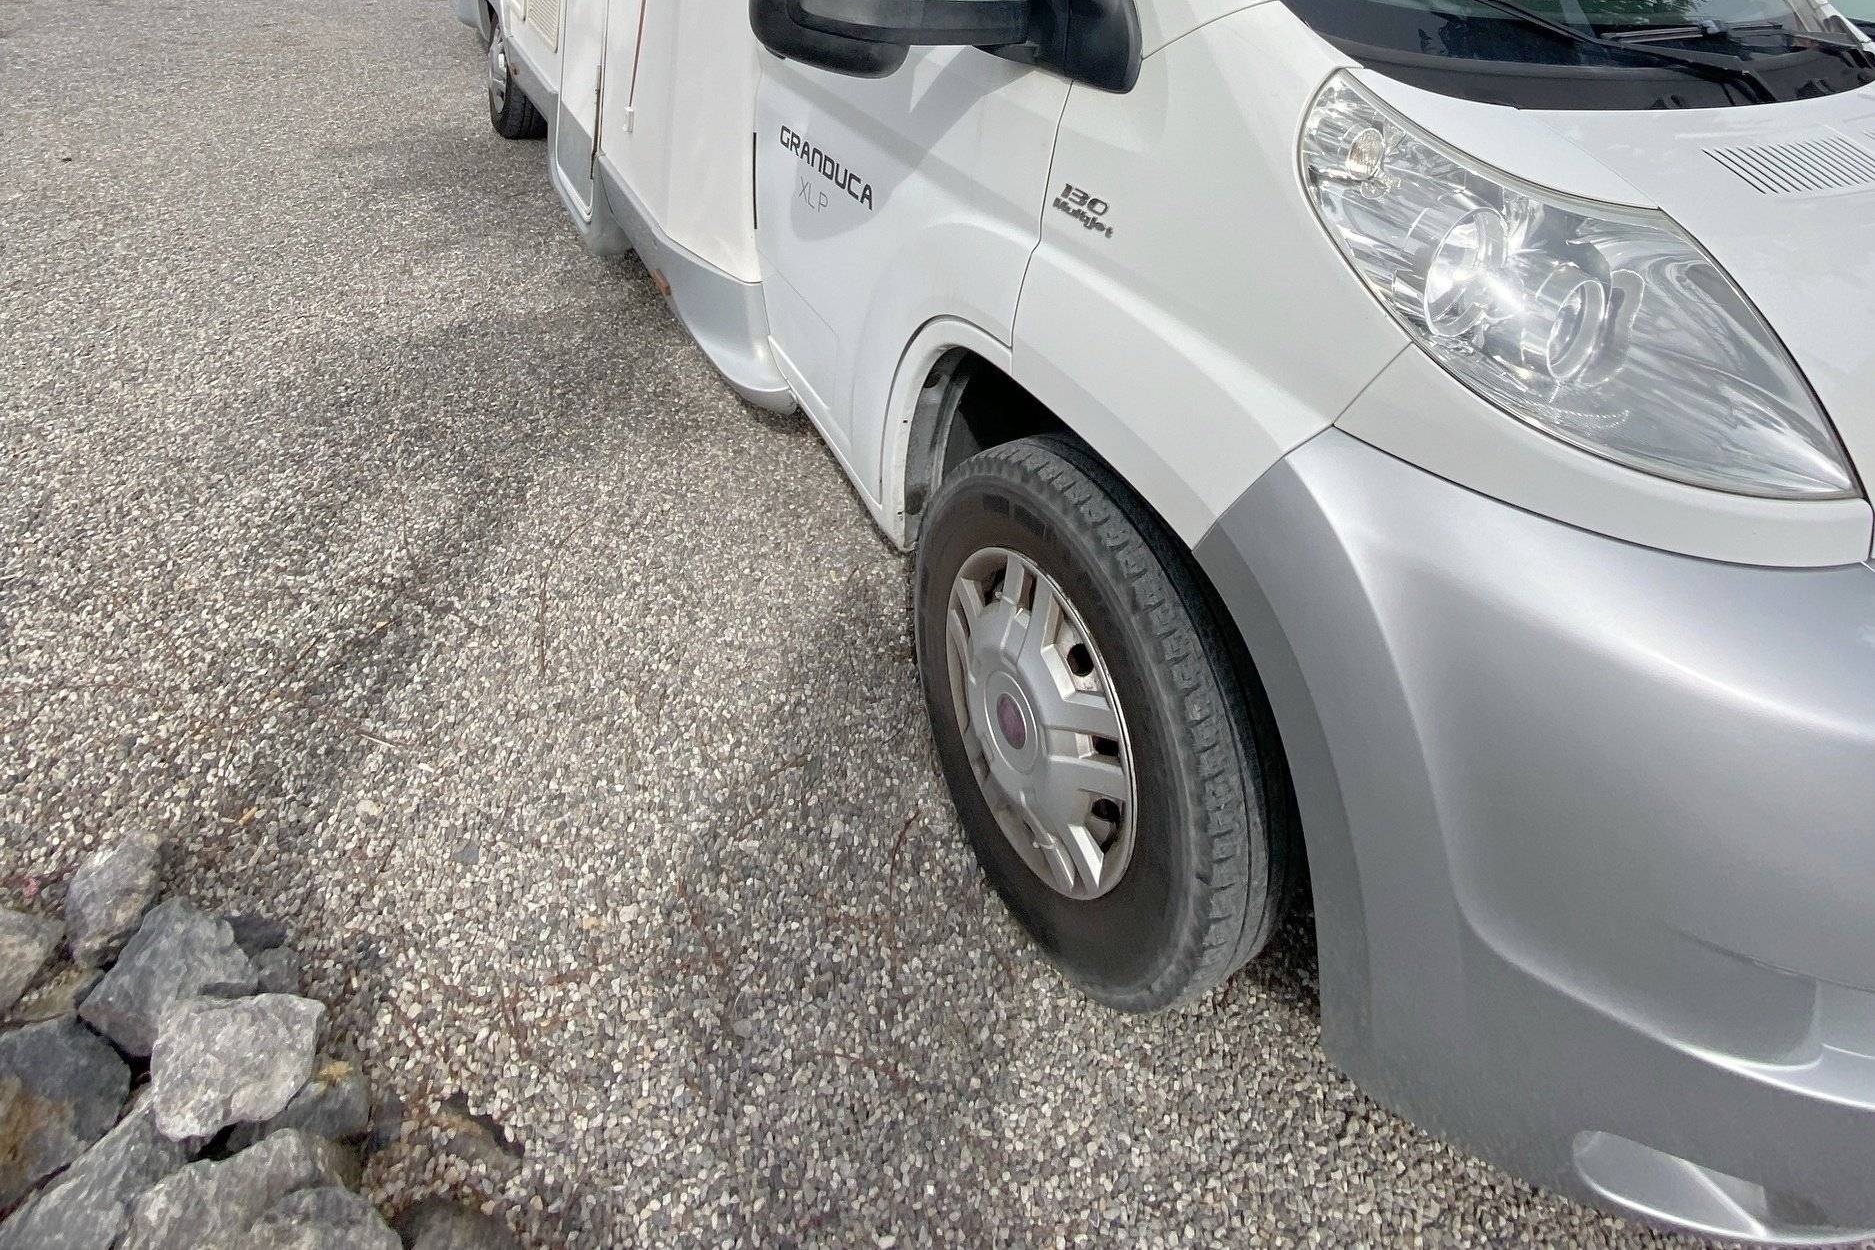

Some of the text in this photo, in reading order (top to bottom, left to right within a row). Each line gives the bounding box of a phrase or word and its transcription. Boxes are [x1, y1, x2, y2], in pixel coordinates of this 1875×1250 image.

[780, 125, 873, 211] GRANDUCA
[799, 176, 829, 212] XLP
[1061, 183, 1108, 216] 130
